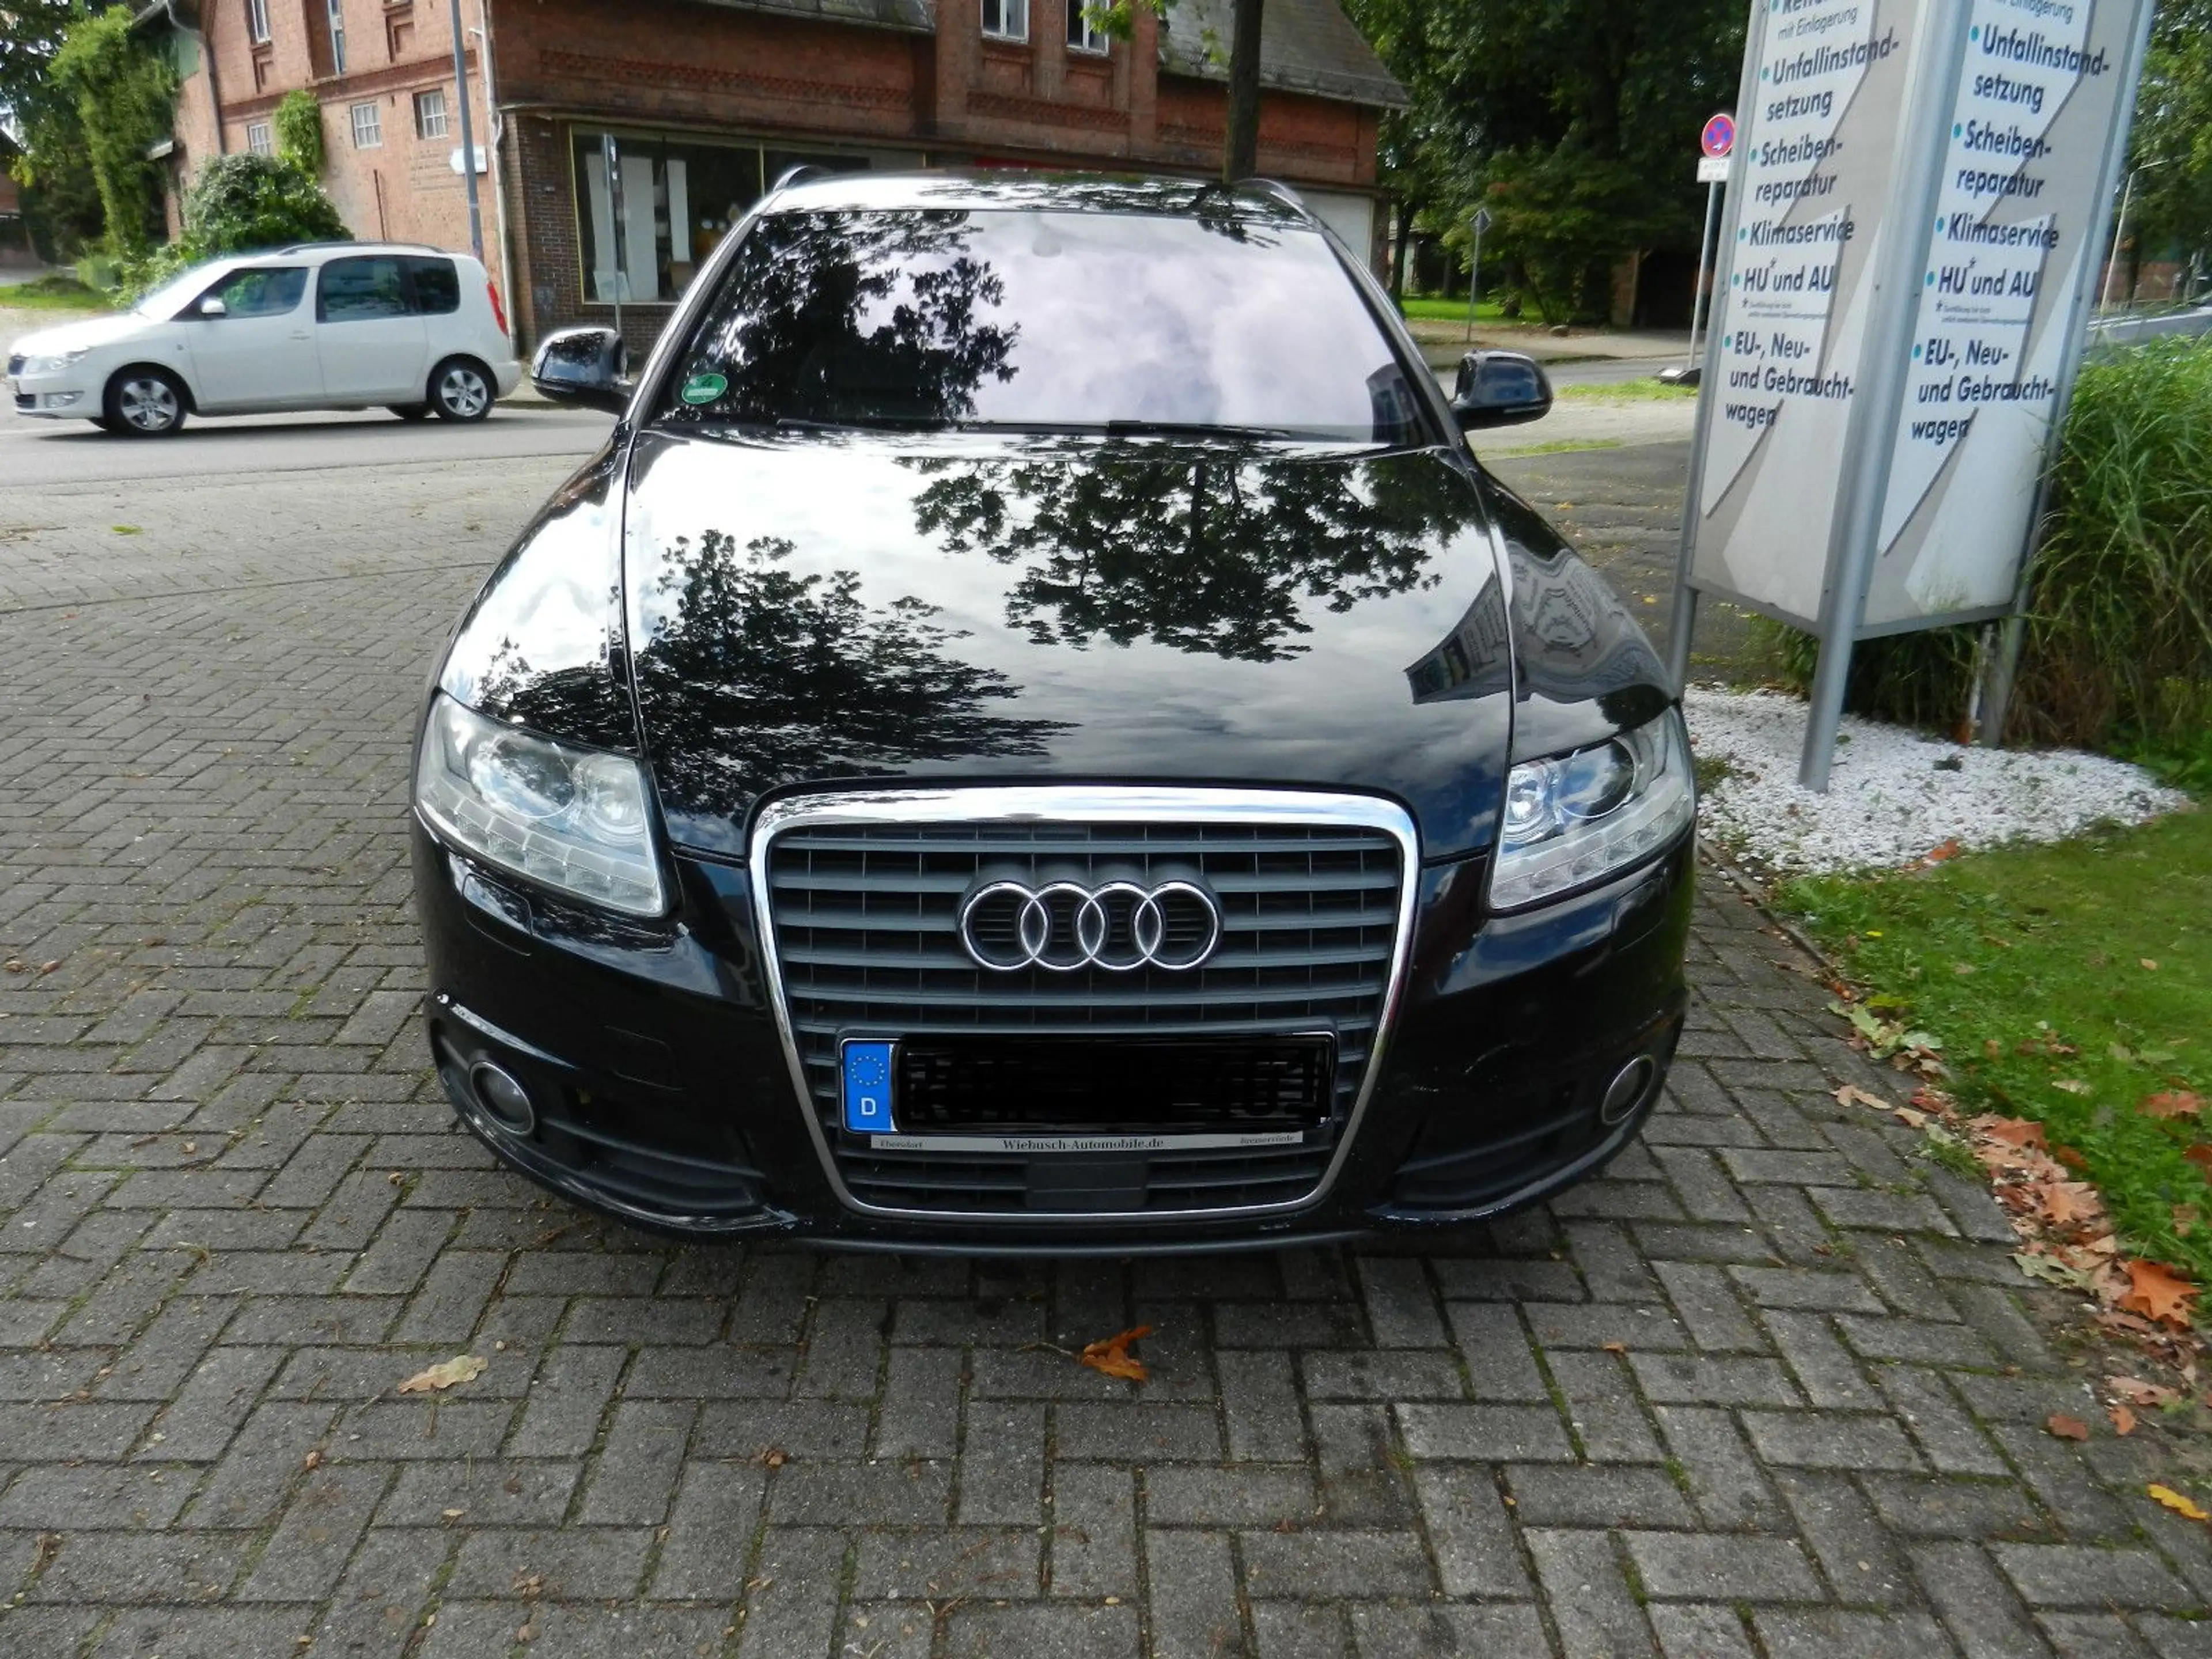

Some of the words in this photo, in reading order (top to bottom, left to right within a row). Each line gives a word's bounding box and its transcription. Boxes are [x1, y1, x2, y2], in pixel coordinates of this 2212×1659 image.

[1796, 6, 1858, 36] Einlagerung
[1772, 26, 1899, 85] Unfallinstand-
[1983, 23, 2109, 77] Unfallinstand-
[1767, 90, 1833, 122] setzung
[1974, 74, 2044, 114] setzung
[1760, 134, 1843, 167] Scheiben-
[1964, 119, 2052, 158] Scheiben-
[1755, 174, 1838, 207] reparatur
[1956, 169, 2044, 199] reparatur
[1749, 214, 1854, 246] Klimaservice
[1947, 213, 2059, 249] Klimaservice
[1772, 265, 1805, 291] und
[1807, 265, 1834, 291] AU
[1971, 268, 2007, 296] und
[2008, 270, 2037, 298] AU
[1734, 331, 1765, 359] EU-,
[1770, 332, 1810, 359] Neu-
[1924, 338, 1960, 370] EU-,
[1965, 339, 2009, 366] Neu-
[1730, 365, 1760, 389] und
[1764, 366, 1854, 399] Gebraucht-
[1918, 375, 1953, 403] und
[1957, 374, 2055, 402] Gebraucht-
[1725, 403, 1777, 429] wagen
[1911, 419, 1971, 445] wagen
[861, 1097, 876, 1116] D
